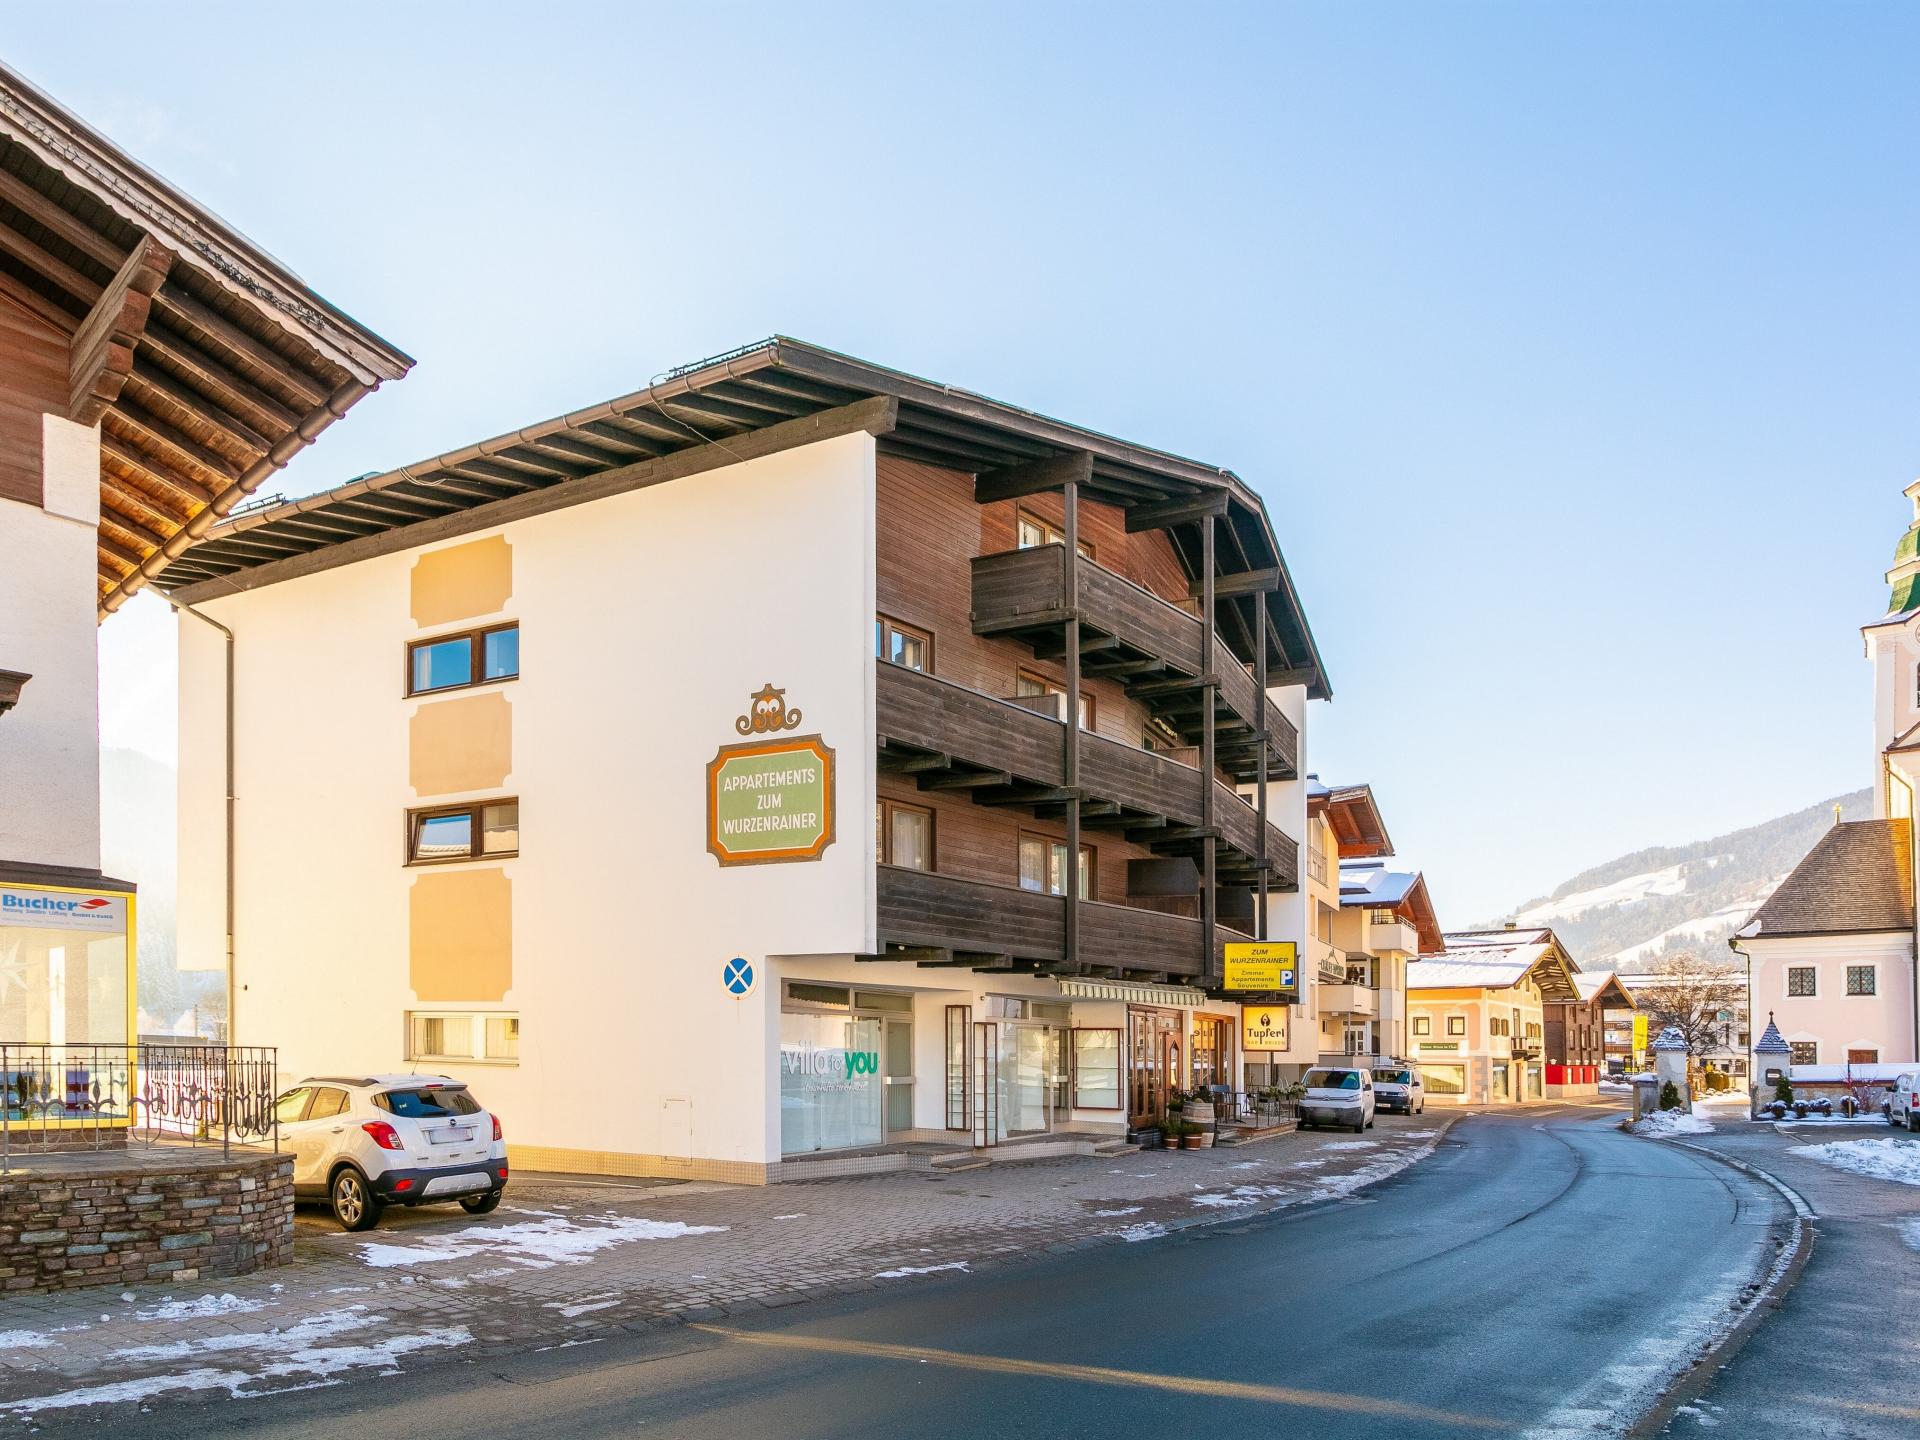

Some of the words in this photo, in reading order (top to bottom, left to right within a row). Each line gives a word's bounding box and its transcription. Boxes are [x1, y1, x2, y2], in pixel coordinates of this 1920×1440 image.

[723, 768, 816, 792] APPARTEMENTS
[757, 793, 782, 810] ZUM
[723, 812, 817, 835] WURZENRAINER
[2, 894, 78, 911] Bucher
[1280, 970, 1293, 985] P
[1246, 1027, 1285, 1045] Tupferl
[783, 1039, 829, 1076] villa
[830, 1055, 843, 1072] to
[844, 1051, 878, 1081] you
